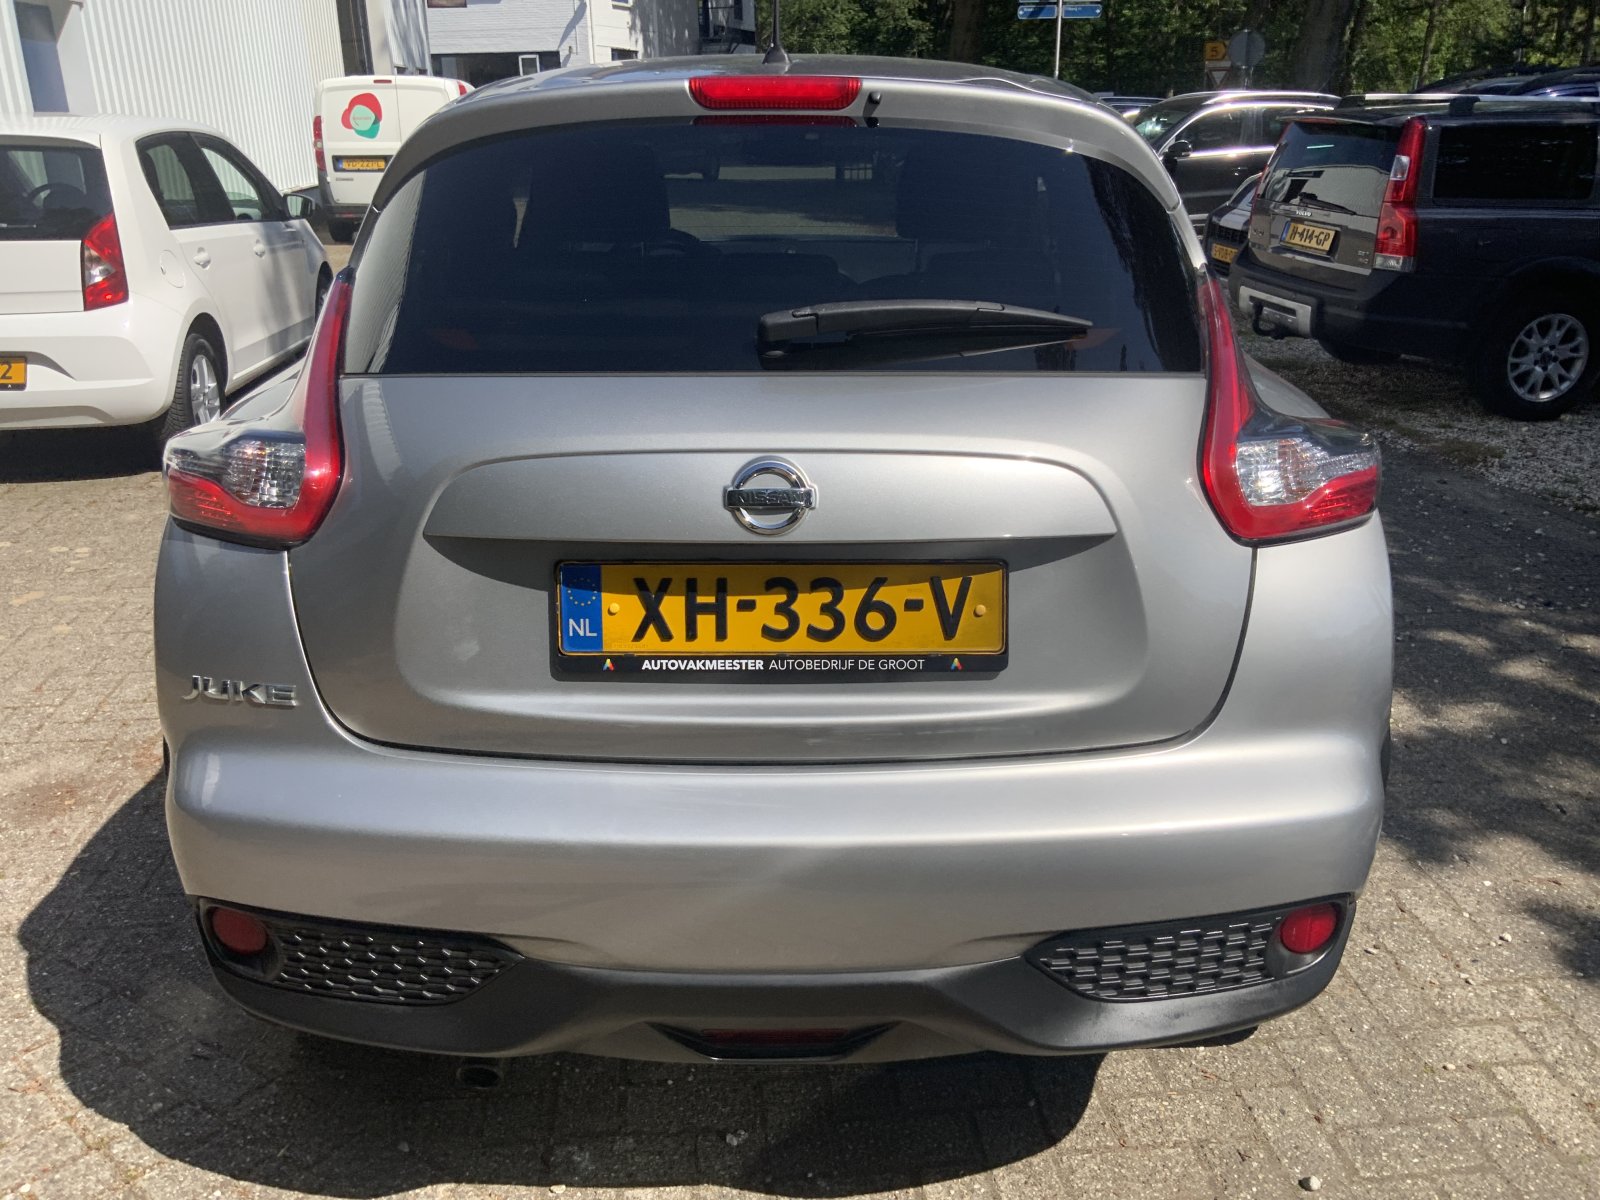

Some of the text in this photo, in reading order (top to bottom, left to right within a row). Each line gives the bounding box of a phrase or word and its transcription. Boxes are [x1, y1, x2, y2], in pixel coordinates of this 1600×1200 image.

[631, 576, 973, 642] XH-336-V
[568, 618, 597, 637] NL
[641, 659, 925, 671] AUTOVAKMEESTER AUTOBEDRIJF DE GROOT
[182, 674, 299, 706] JUKE
